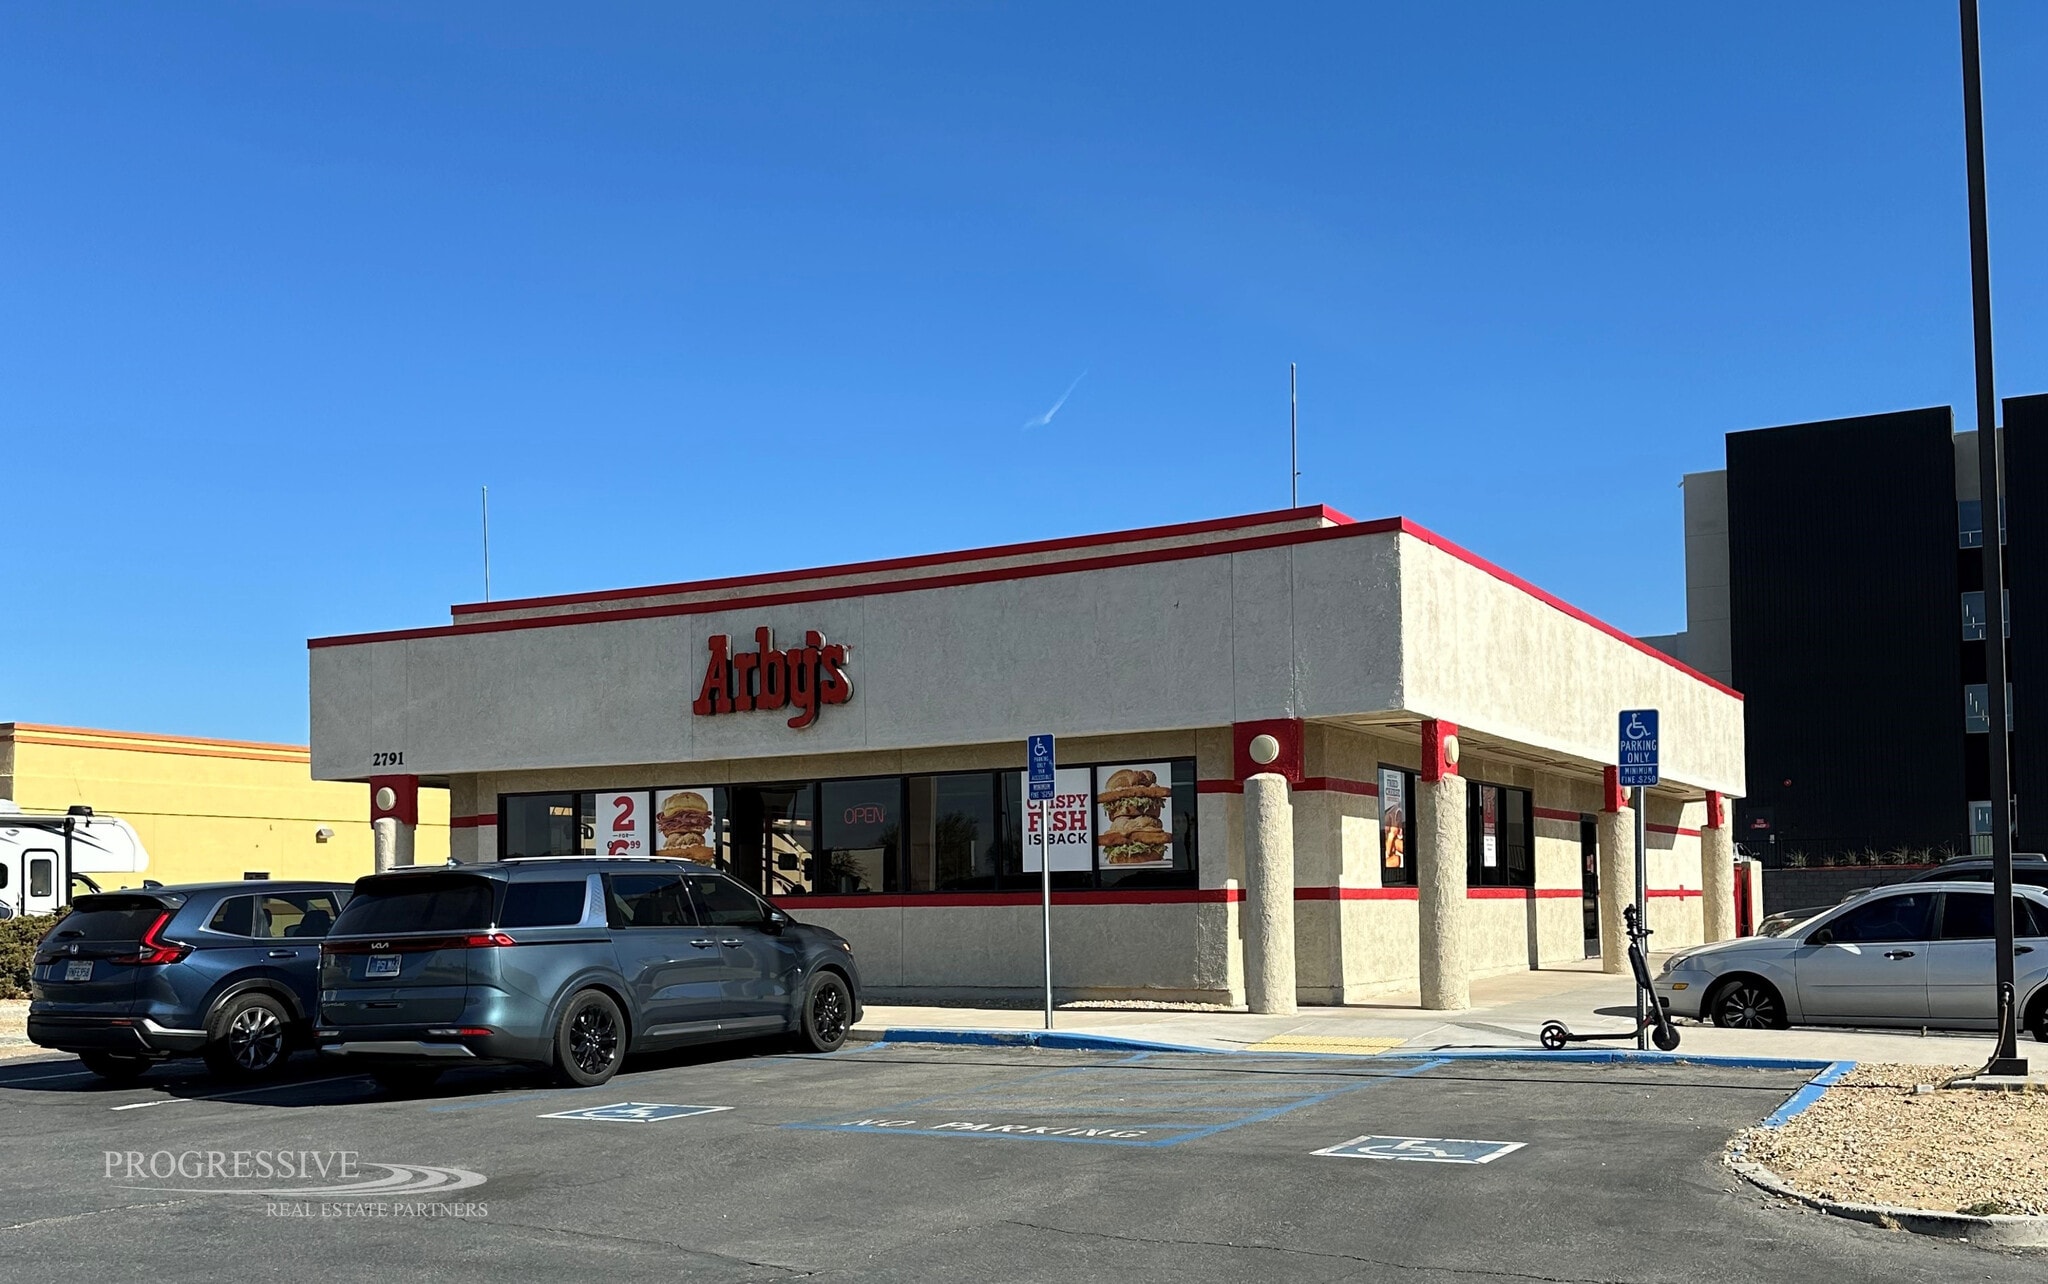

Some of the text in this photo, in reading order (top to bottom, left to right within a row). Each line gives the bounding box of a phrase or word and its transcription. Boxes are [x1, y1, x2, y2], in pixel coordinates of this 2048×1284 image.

[693, 626, 853, 728] Arby's
[1621, 740, 1656, 752] PARKING
[373, 751, 404, 766] 2791
[1628, 752, 1649, 763] ONLY
[1624, 767, 1653, 775] MINIMUM
[1621, 775, 1656, 784] FINE $250
[1026, 794, 1088, 809] CISPY
[612, 795, 635, 832] 2
[843, 806, 884, 824] OPEN
[1027, 810, 1087, 832] FSH
[1028, 833, 1088, 845] IS BACK
[840, 1119, 1148, 1138] NO PARKING
